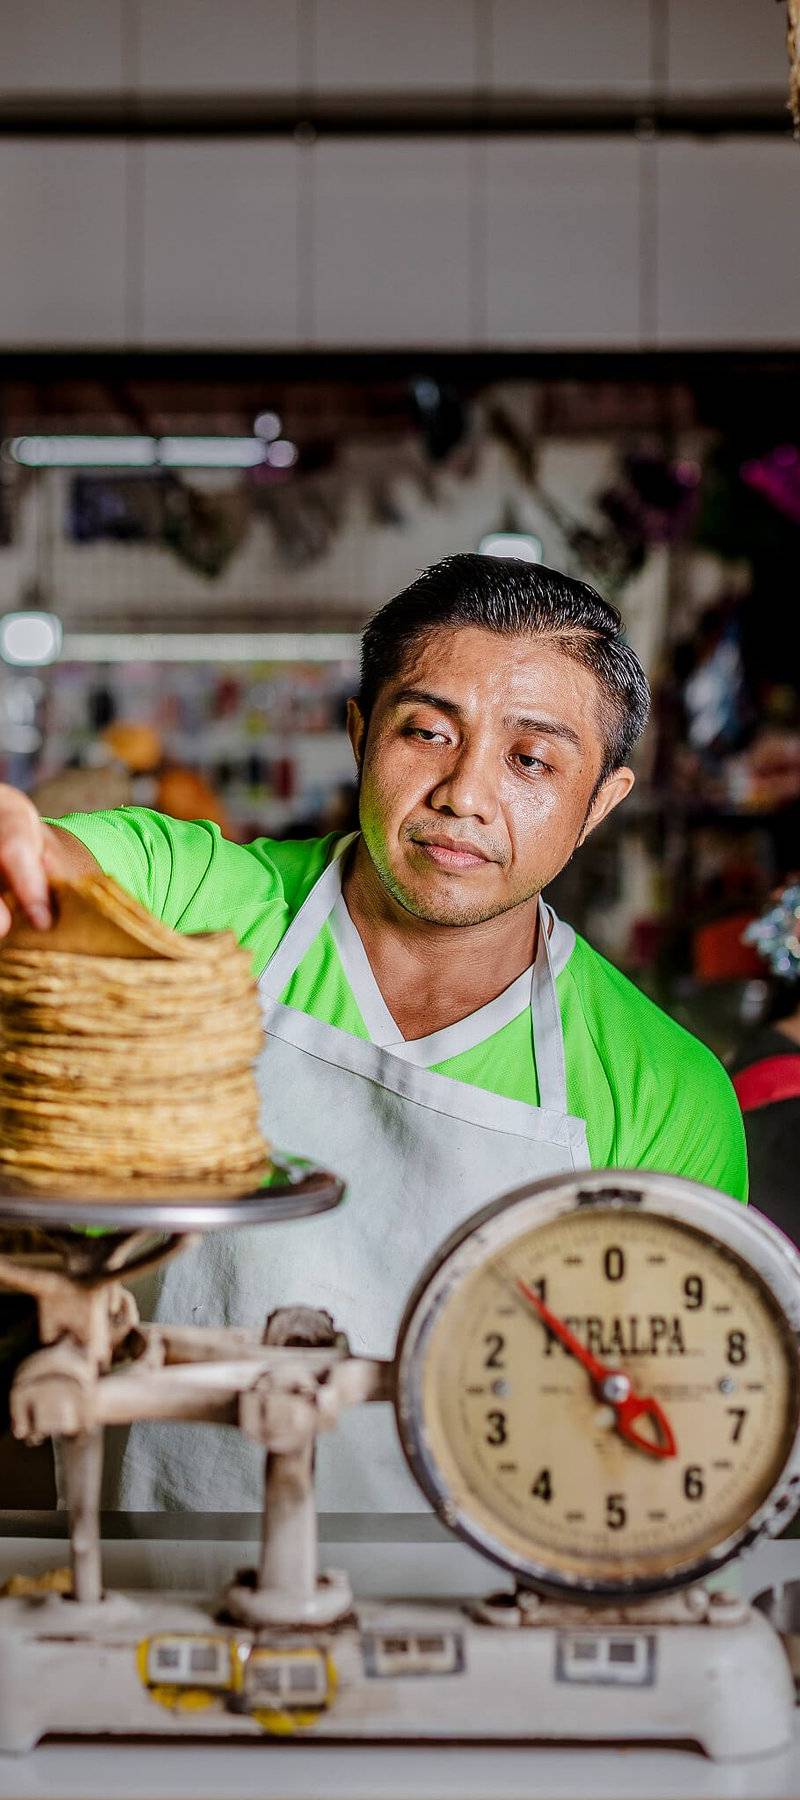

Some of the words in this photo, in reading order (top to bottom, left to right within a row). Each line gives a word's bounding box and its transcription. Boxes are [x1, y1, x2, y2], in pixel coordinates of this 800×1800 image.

[603, 1246, 625, 1283] 0
[534, 1278, 547, 1306] 1
[683, 1274, 704, 1311] 9
[484, 1333, 505, 1369] 2
[726, 1330, 747, 1366] 8
[486, 1411, 507, 1446] 3
[727, 1409, 747, 1443] 7
[531, 1468, 552, 1503] 4
[684, 1466, 704, 1502] 6
[606, 1494, 627, 1531] 5
